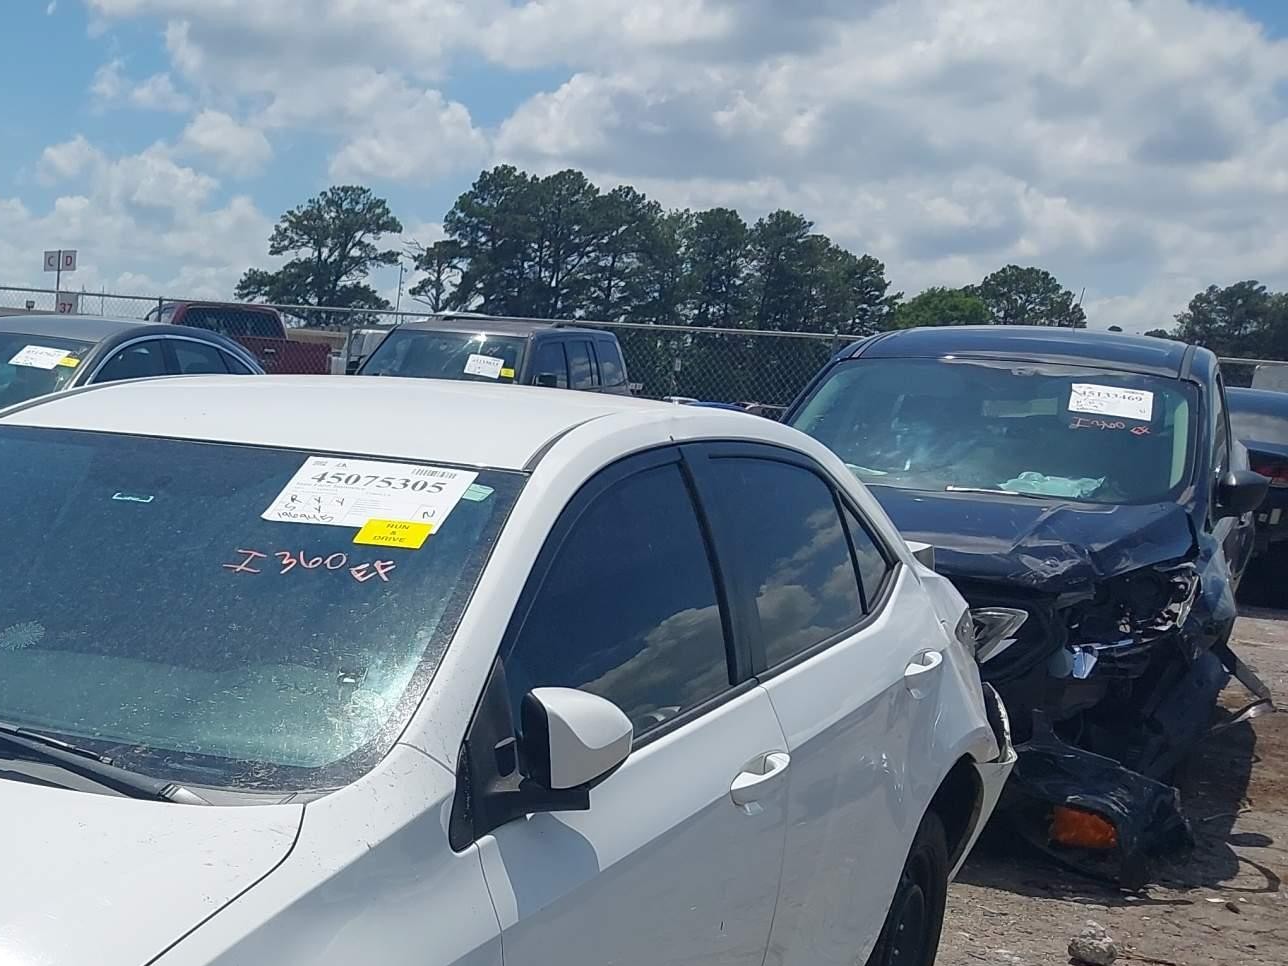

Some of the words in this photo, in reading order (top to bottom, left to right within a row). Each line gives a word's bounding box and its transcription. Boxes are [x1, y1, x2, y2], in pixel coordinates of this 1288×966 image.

[47, 255, 54, 267] C
[65, 255, 73, 266] D
[59, 302, 73, 314] 37
[311, 471, 447, 494] 45075305
[372, 535, 407, 543] DRIVE
